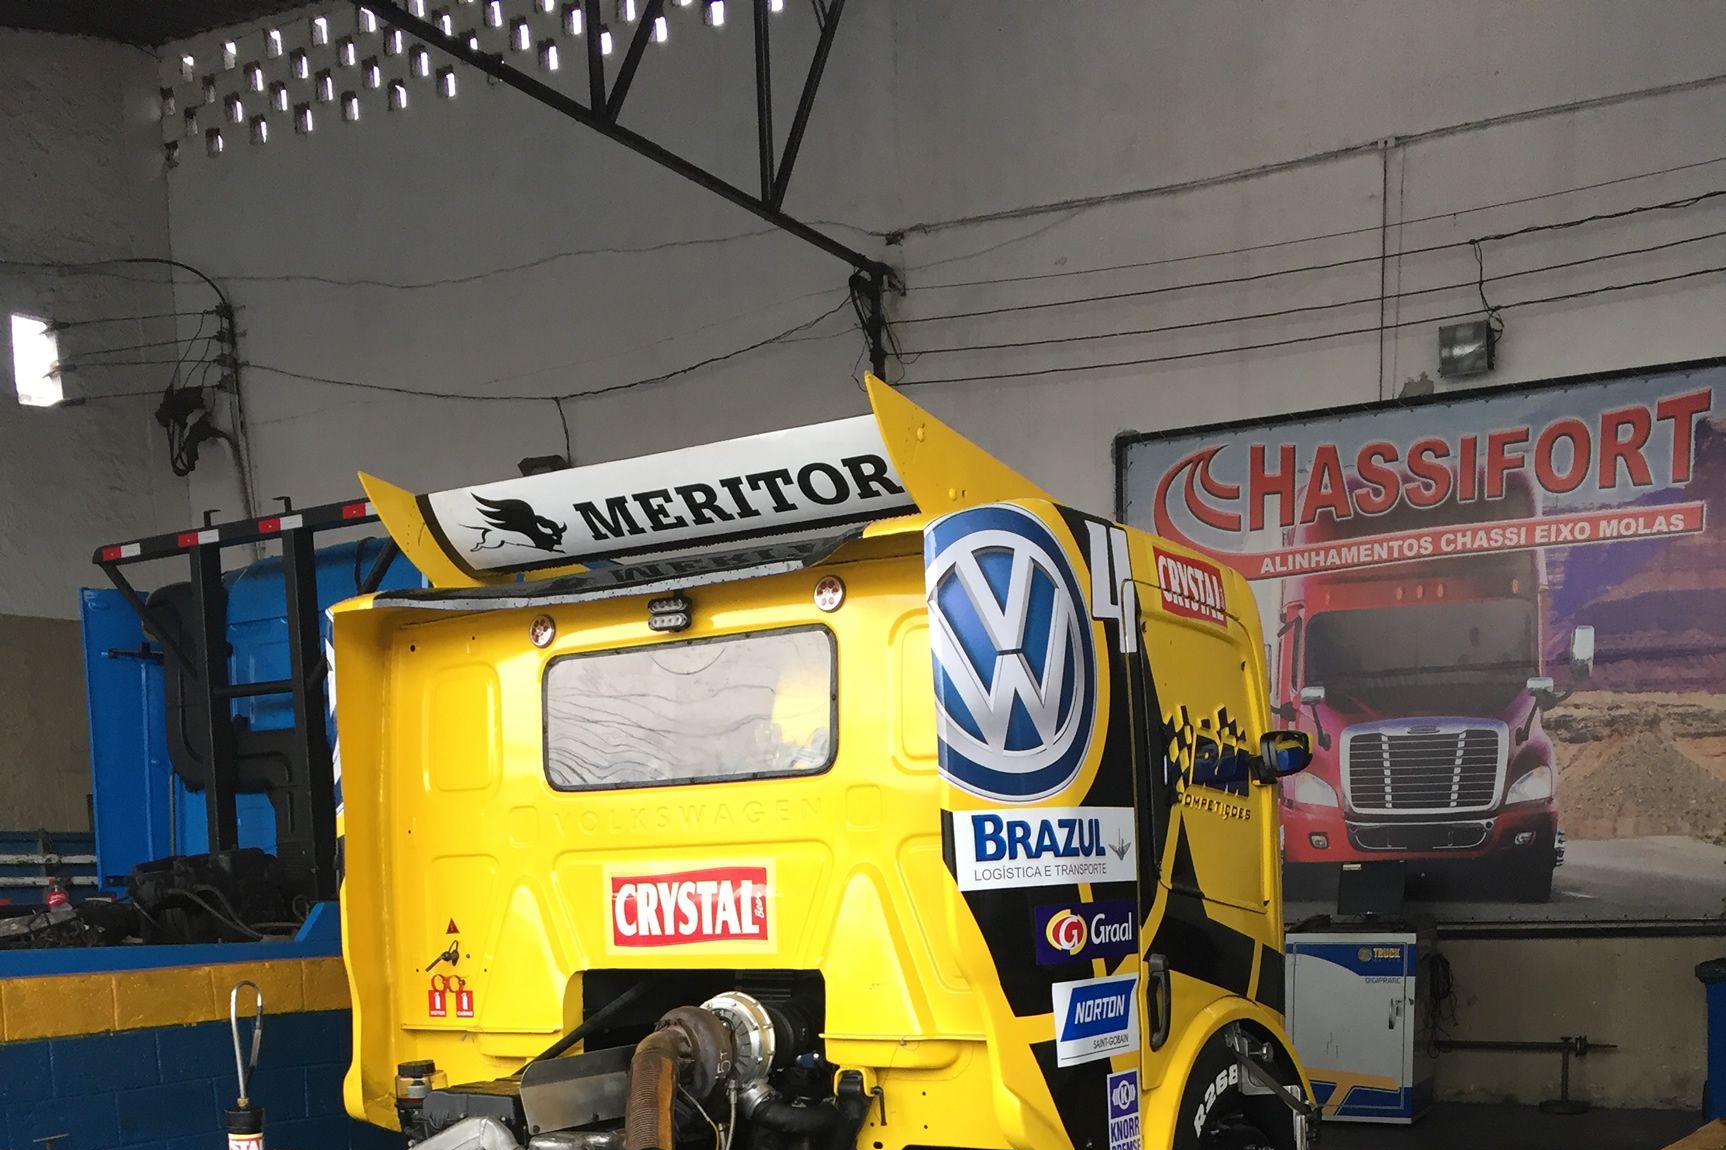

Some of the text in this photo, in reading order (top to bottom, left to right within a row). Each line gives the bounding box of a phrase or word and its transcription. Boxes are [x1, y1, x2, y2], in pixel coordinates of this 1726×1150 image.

[1154, 389, 1712, 533] CHASSIFORT
[572, 453, 906, 541] MERITOR
[1260, 513, 1686, 575] ALINHAMENTOS CHASSI EIXO MOLAS
[1157, 554, 1225, 621] CRYSTAL
[551, 796, 824, 836] VOLKSWAGEN
[971, 813, 1106, 862] BRAZUL
[974, 862, 1108, 881] LOGÍSTICA E TRANSPORTE
[614, 879, 760, 936] CRYSTAL
[1090, 911, 1133, 945] Graal
[1074, 993, 1126, 1025] NORTON
[1093, 1032, 1129, 1050] SAINT-GOBAIN
[1110, 1115, 1140, 1143] KNORR
